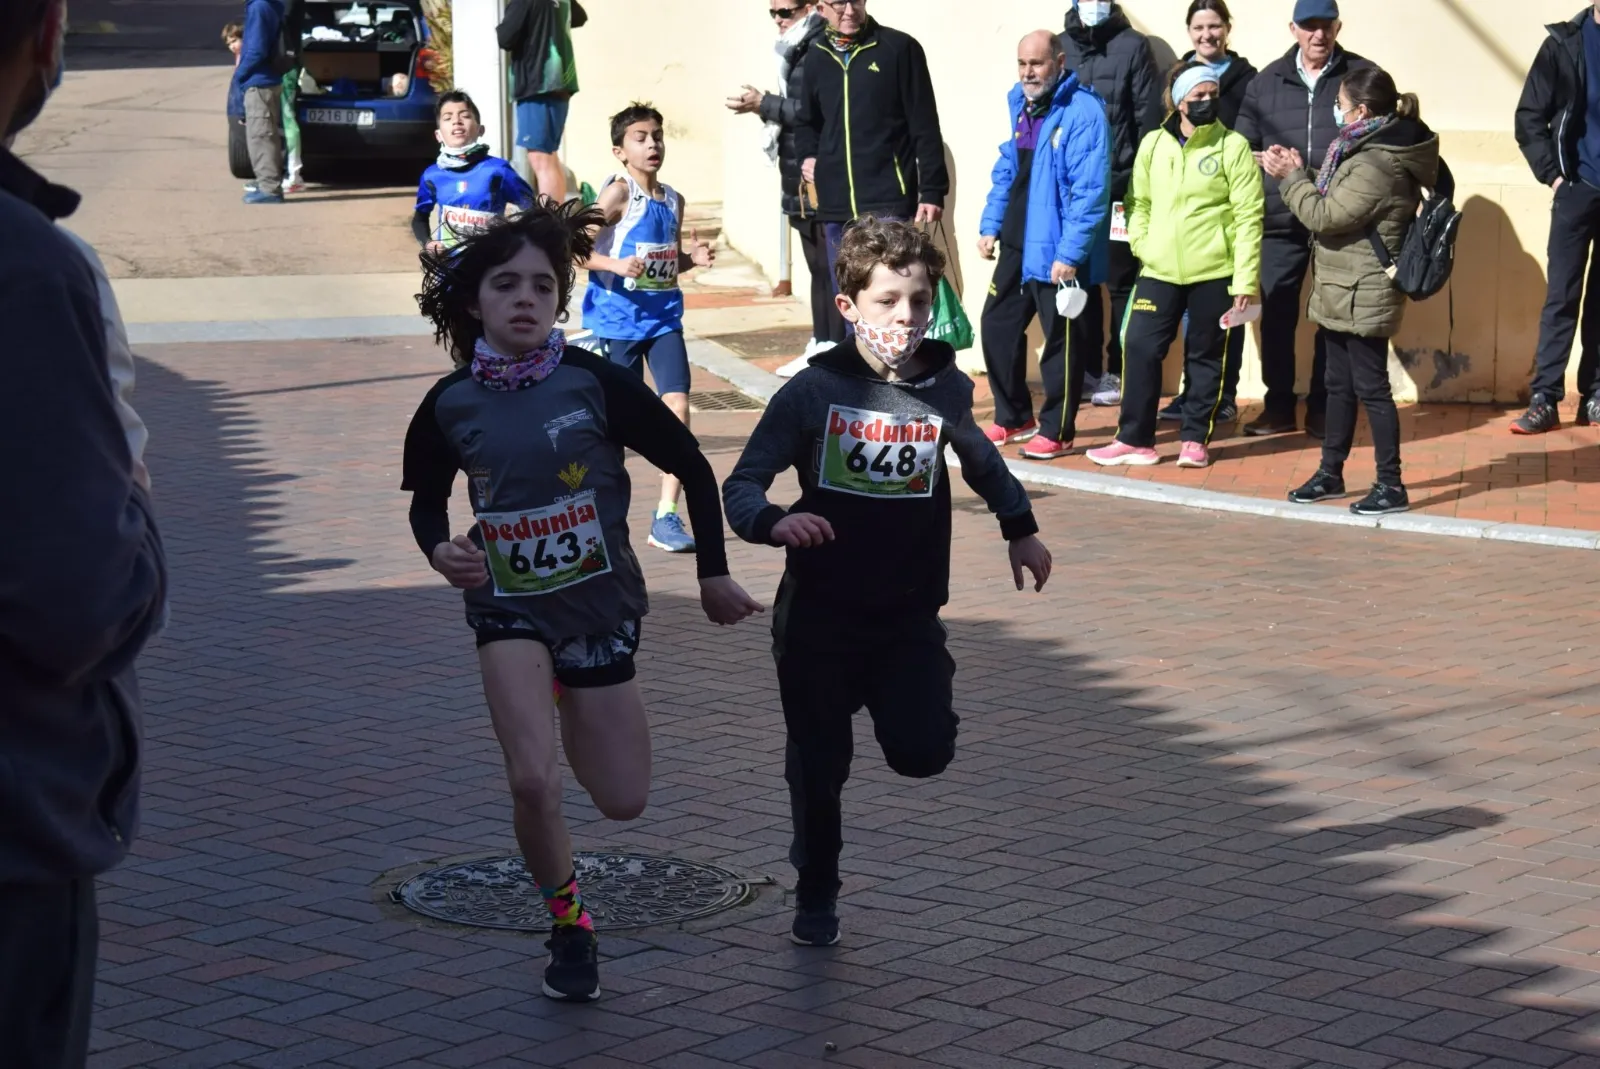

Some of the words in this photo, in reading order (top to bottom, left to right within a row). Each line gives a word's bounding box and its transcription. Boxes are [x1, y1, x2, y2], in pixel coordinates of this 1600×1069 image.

[309, 110, 341, 122] 0216
[646, 260, 675, 279] 642
[829, 410, 938, 443] bedunia
[846, 441, 917, 477] 648
[480, 503, 596, 541] bedunia
[509, 531, 581, 574] 643
